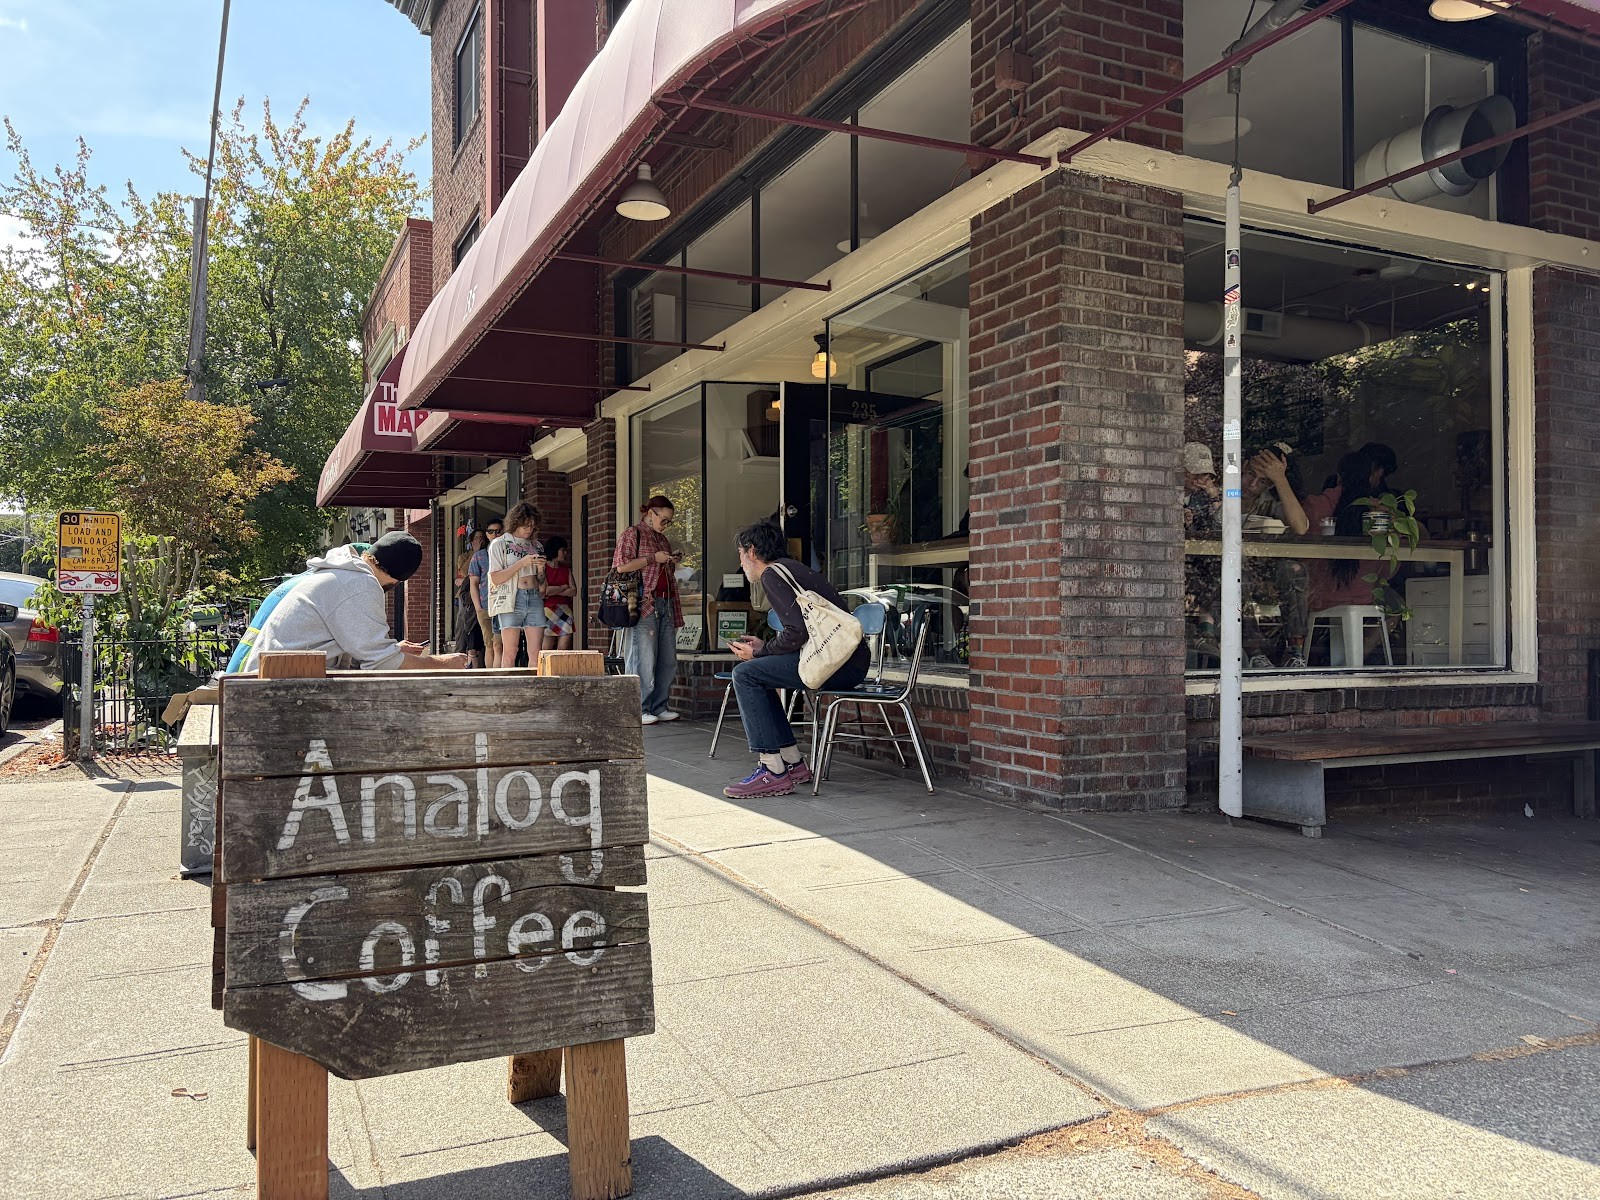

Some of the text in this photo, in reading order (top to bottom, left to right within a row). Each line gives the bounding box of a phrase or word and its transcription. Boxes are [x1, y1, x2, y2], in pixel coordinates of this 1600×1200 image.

[852, 401, 877, 420] 235
[63, 514, 116, 525] 30 MINUTE
[68, 527, 112, 536] LOAD AND
[71, 537, 108, 545] UNLOAD
[84, 547, 102, 555] NLY
[277, 733, 605, 885] Analog
[279, 874, 607, 1001] Coffee
